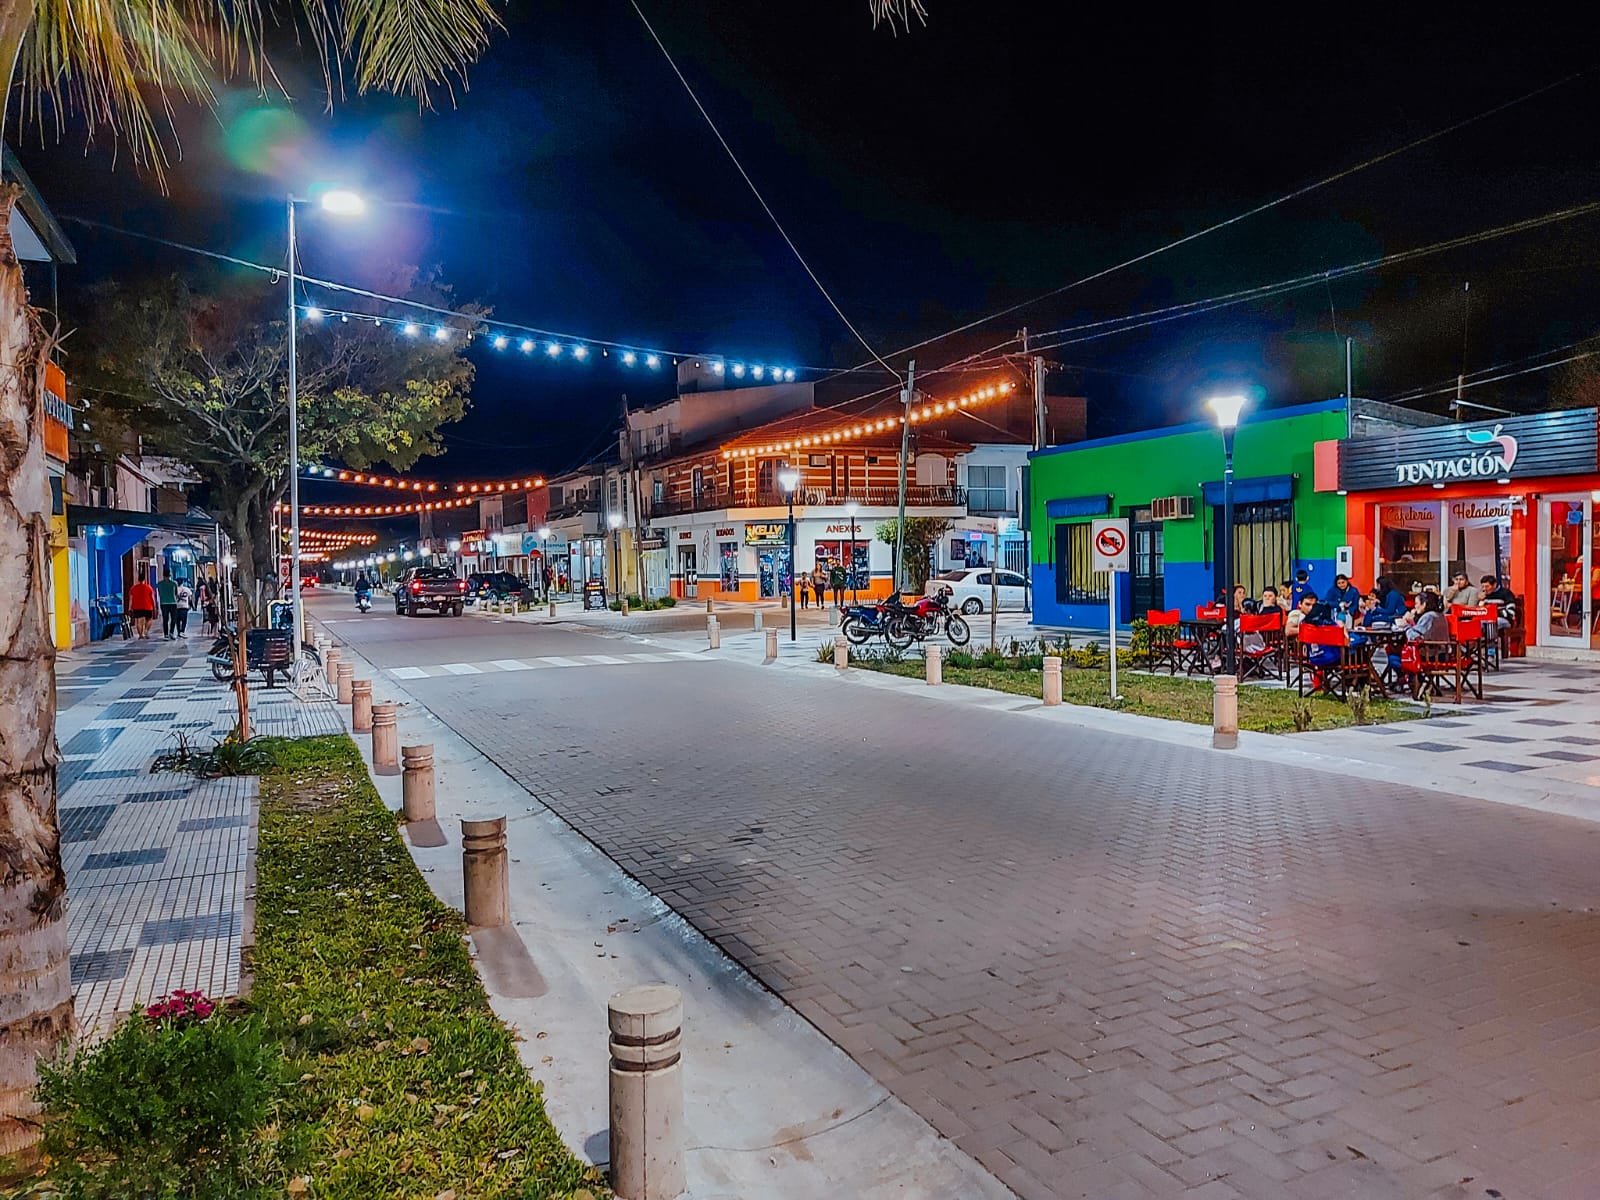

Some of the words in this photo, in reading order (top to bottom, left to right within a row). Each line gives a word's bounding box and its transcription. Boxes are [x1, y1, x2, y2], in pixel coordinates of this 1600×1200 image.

[1395, 450, 1512, 483] TENTACIÓN
[1453, 502, 1509, 519] Heladería
[752, 525, 782, 536] KELLY
